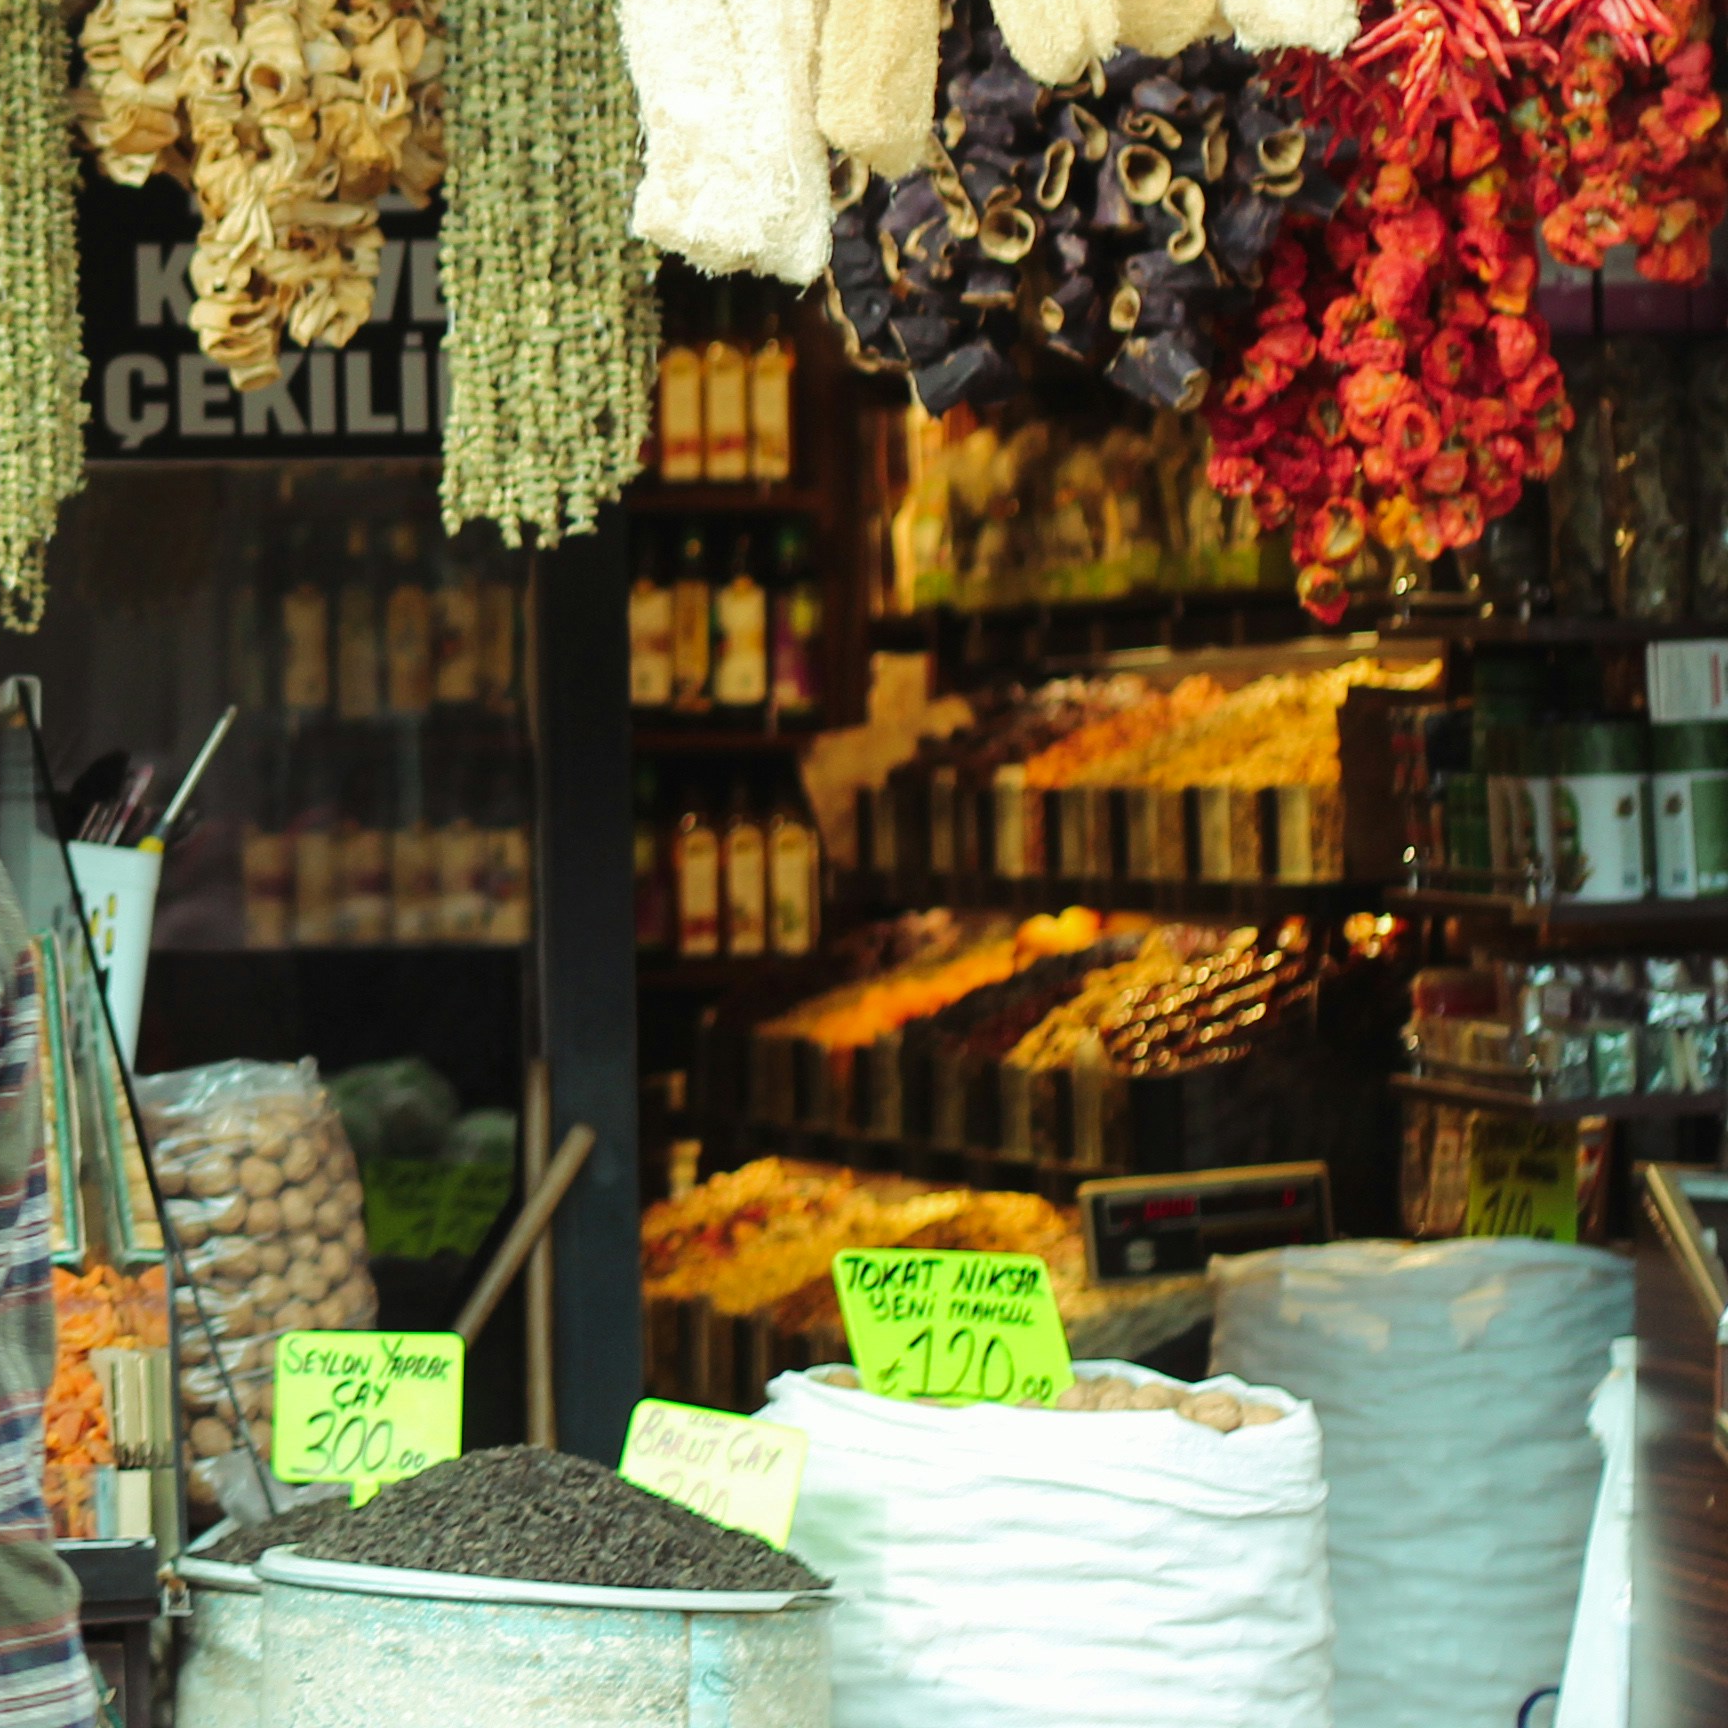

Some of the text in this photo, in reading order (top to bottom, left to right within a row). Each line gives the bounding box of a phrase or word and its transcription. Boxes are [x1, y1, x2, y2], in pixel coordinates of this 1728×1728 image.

[843, 1255, 944, 1292] TOKAT
[282, 1336, 455, 1383] SEYLON YAPRAK
[331, 1378, 391, 1412] ÇAY
[726, 1429, 784, 1475] ÇAY
